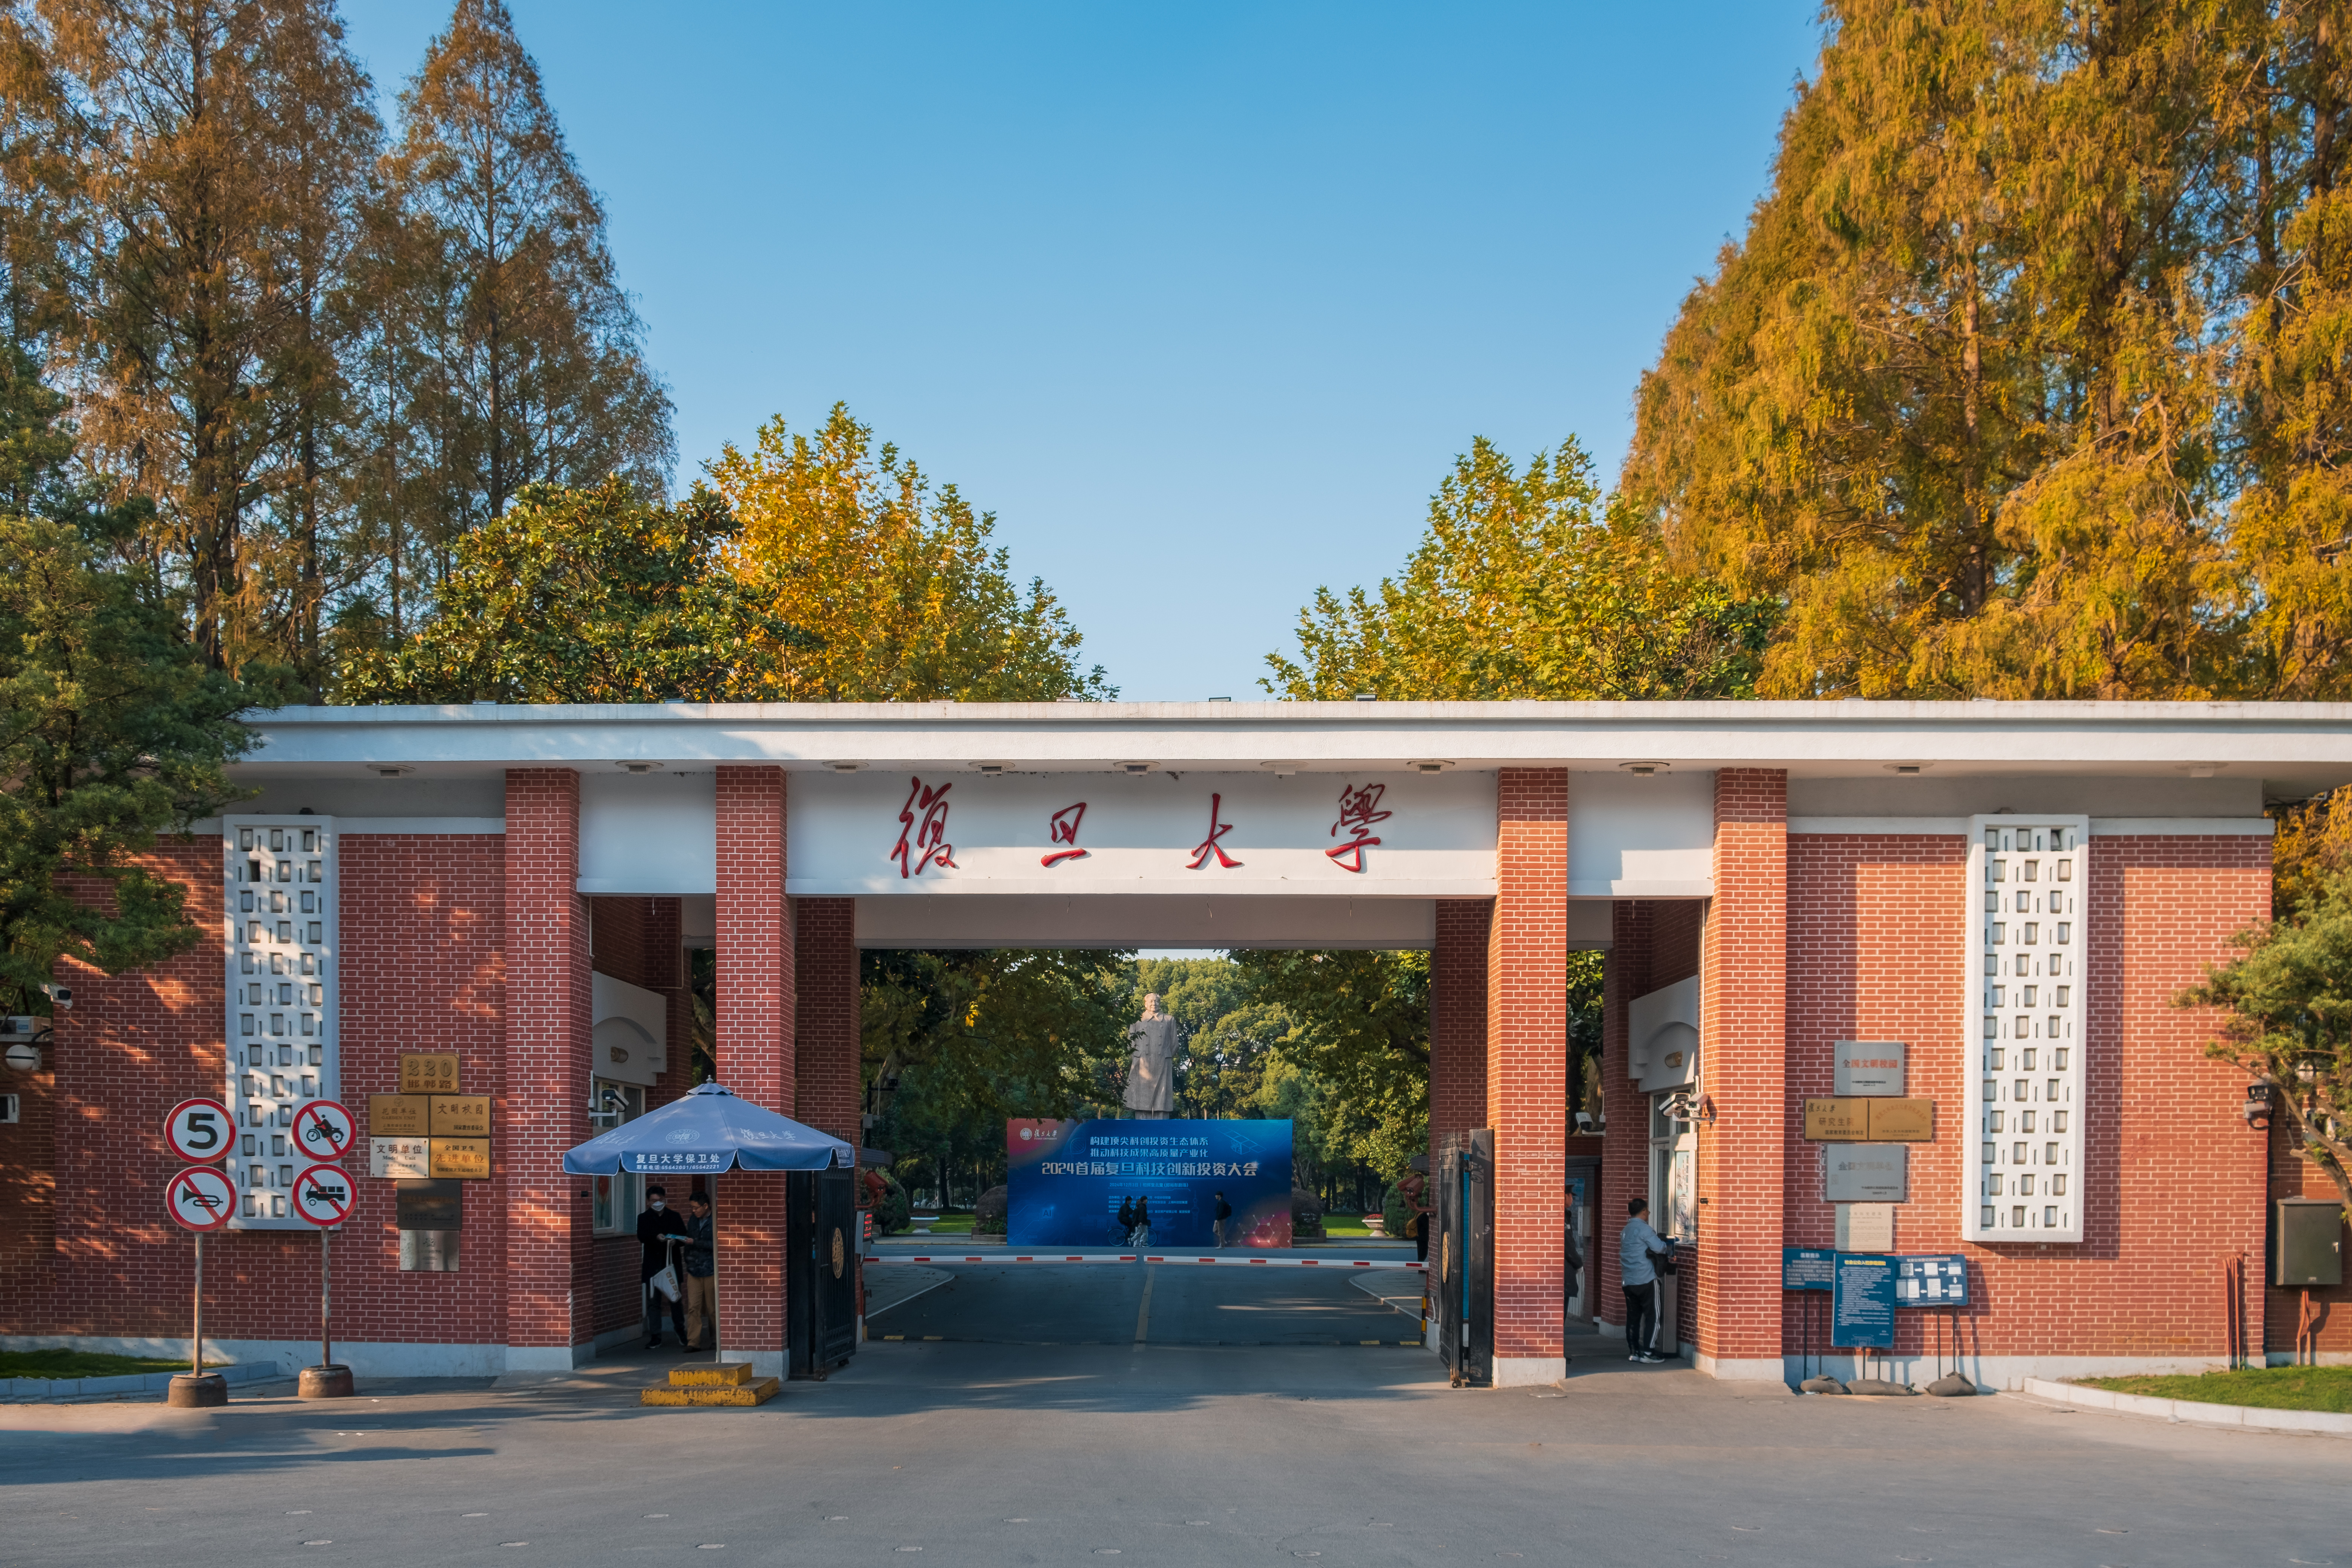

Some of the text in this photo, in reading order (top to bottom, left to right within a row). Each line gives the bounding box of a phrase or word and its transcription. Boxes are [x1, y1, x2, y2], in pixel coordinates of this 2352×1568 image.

[407, 1059, 452, 1077] 220
[1842, 1059, 1898, 1069] 全国文明校园
[407, 1080, 452, 1089] 邯郸路
[437, 1104, 483, 1115] 文明校园
[1819, 1118, 1854, 1126] 研究生院
[186, 1113, 218, 1150] 5
[1090, 1136, 1209, 1146] 构建顶尖科创投资生态体系
[376, 1144, 422, 1154] 文明单位
[1090, 1148, 1209, 1158] 推动科技成果高质量产业化
[435, 1154, 484, 1163] 先进单位
[636, 1153, 720, 1164] 复旦大学保卫处
[1041, 1162, 1257, 1176] 2024首届复旦科技创新投资大会
[1043, 1208, 1052, 1217] AI
